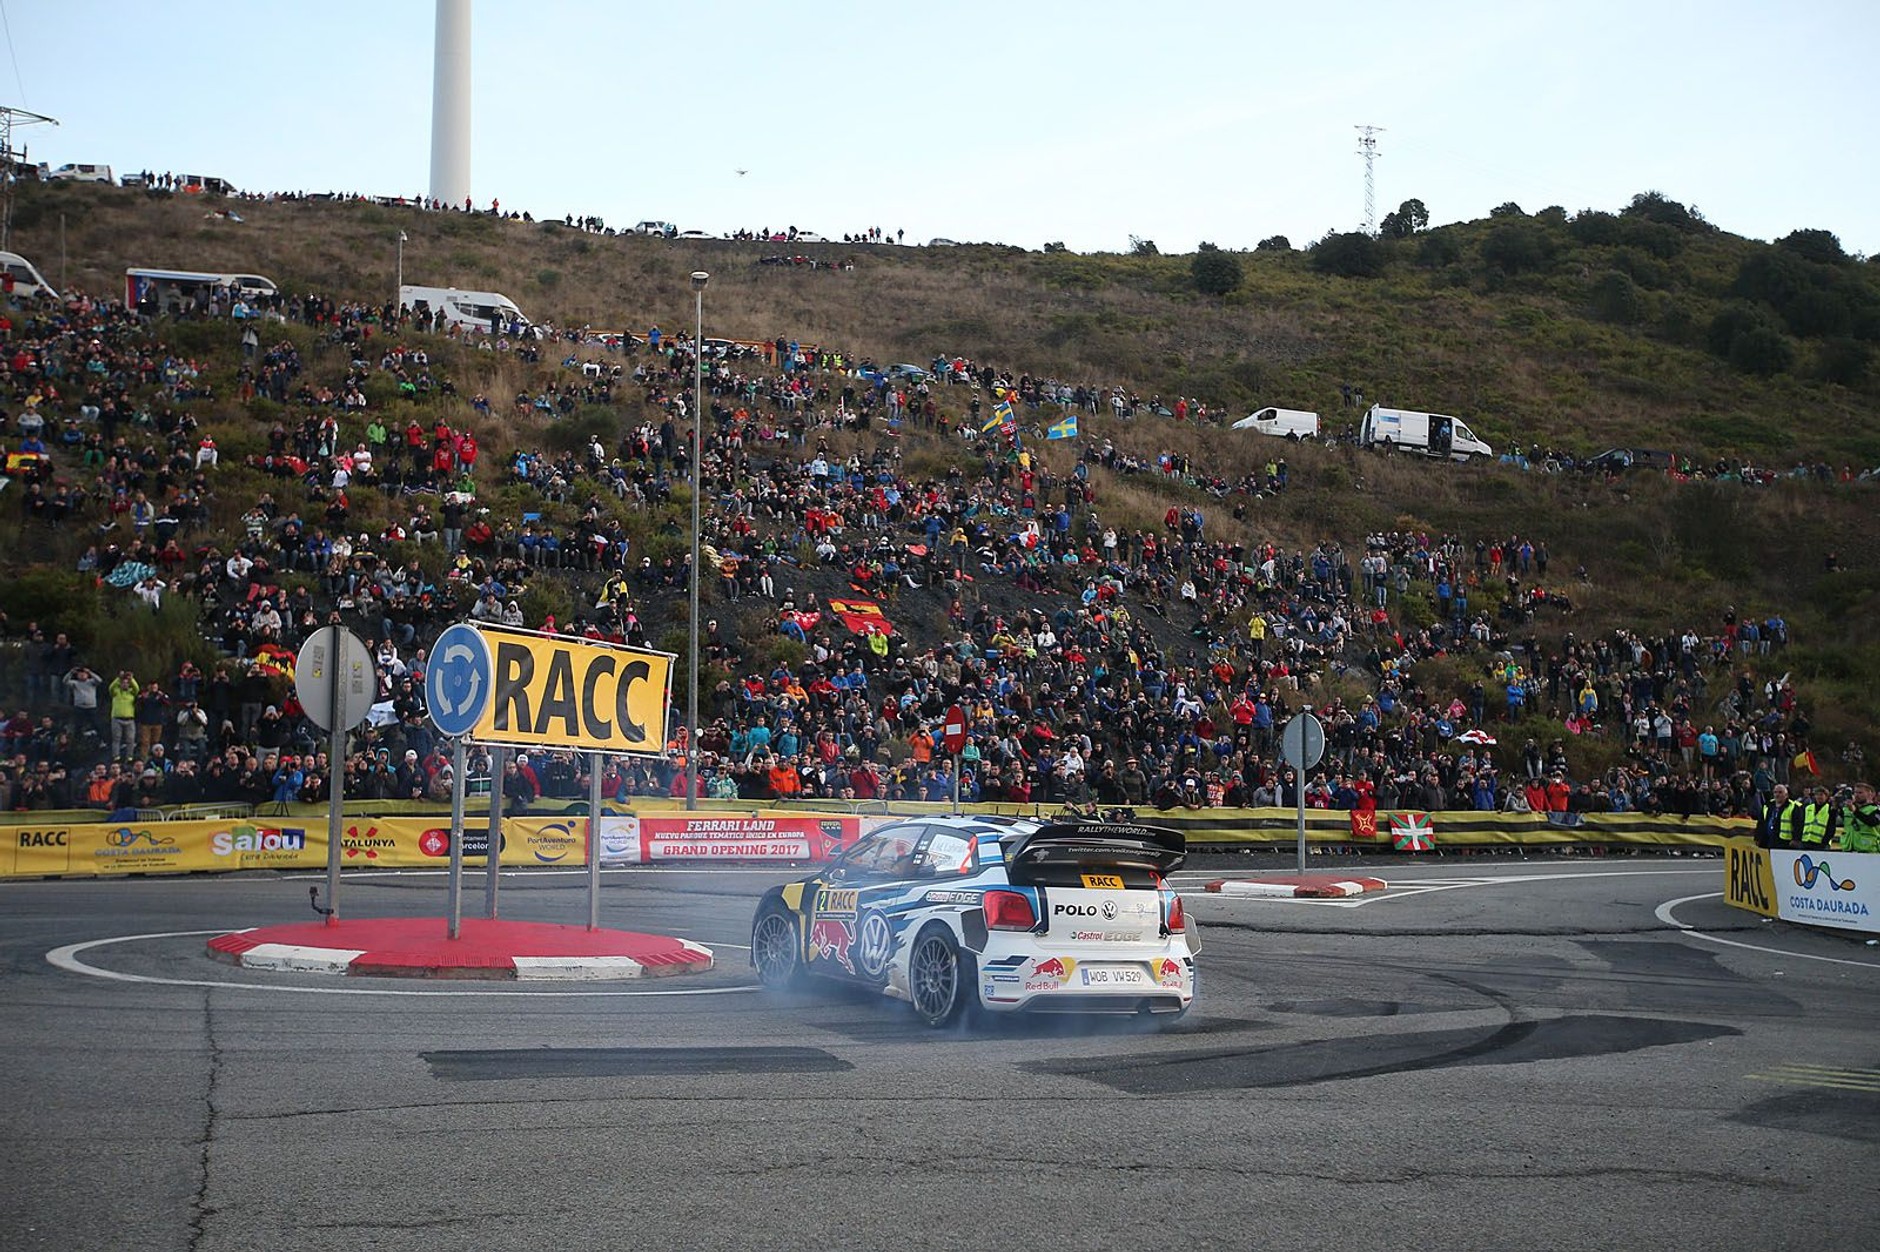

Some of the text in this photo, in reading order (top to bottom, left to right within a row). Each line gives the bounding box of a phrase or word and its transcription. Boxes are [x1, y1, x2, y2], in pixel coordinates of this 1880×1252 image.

[493, 642, 650, 743] RACC
[686, 820, 776, 831] FERRARI LAND
[20, 831, 67, 847] RACC
[654, 832, 679, 840] NUEVO
[212, 831, 300, 857] Salou
[341, 839, 396, 847] TALUNYA
[663, 844, 800, 855] GRAND OPENING 2017
[1089, 876, 1118, 887] RACC
[1730, 848, 1770, 911] RACC
[819, 891, 855, 911] 2 RACC
[949, 892, 980, 904] EDGE
[1054, 904, 1098, 916] POLO
[1790, 895, 1869, 916] COSTA DAURADA
[1077, 930, 1143, 941] Castrol EDGE
[1090, 971, 1108, 982] WOB
[1025, 981, 1059, 990] Red Bull
